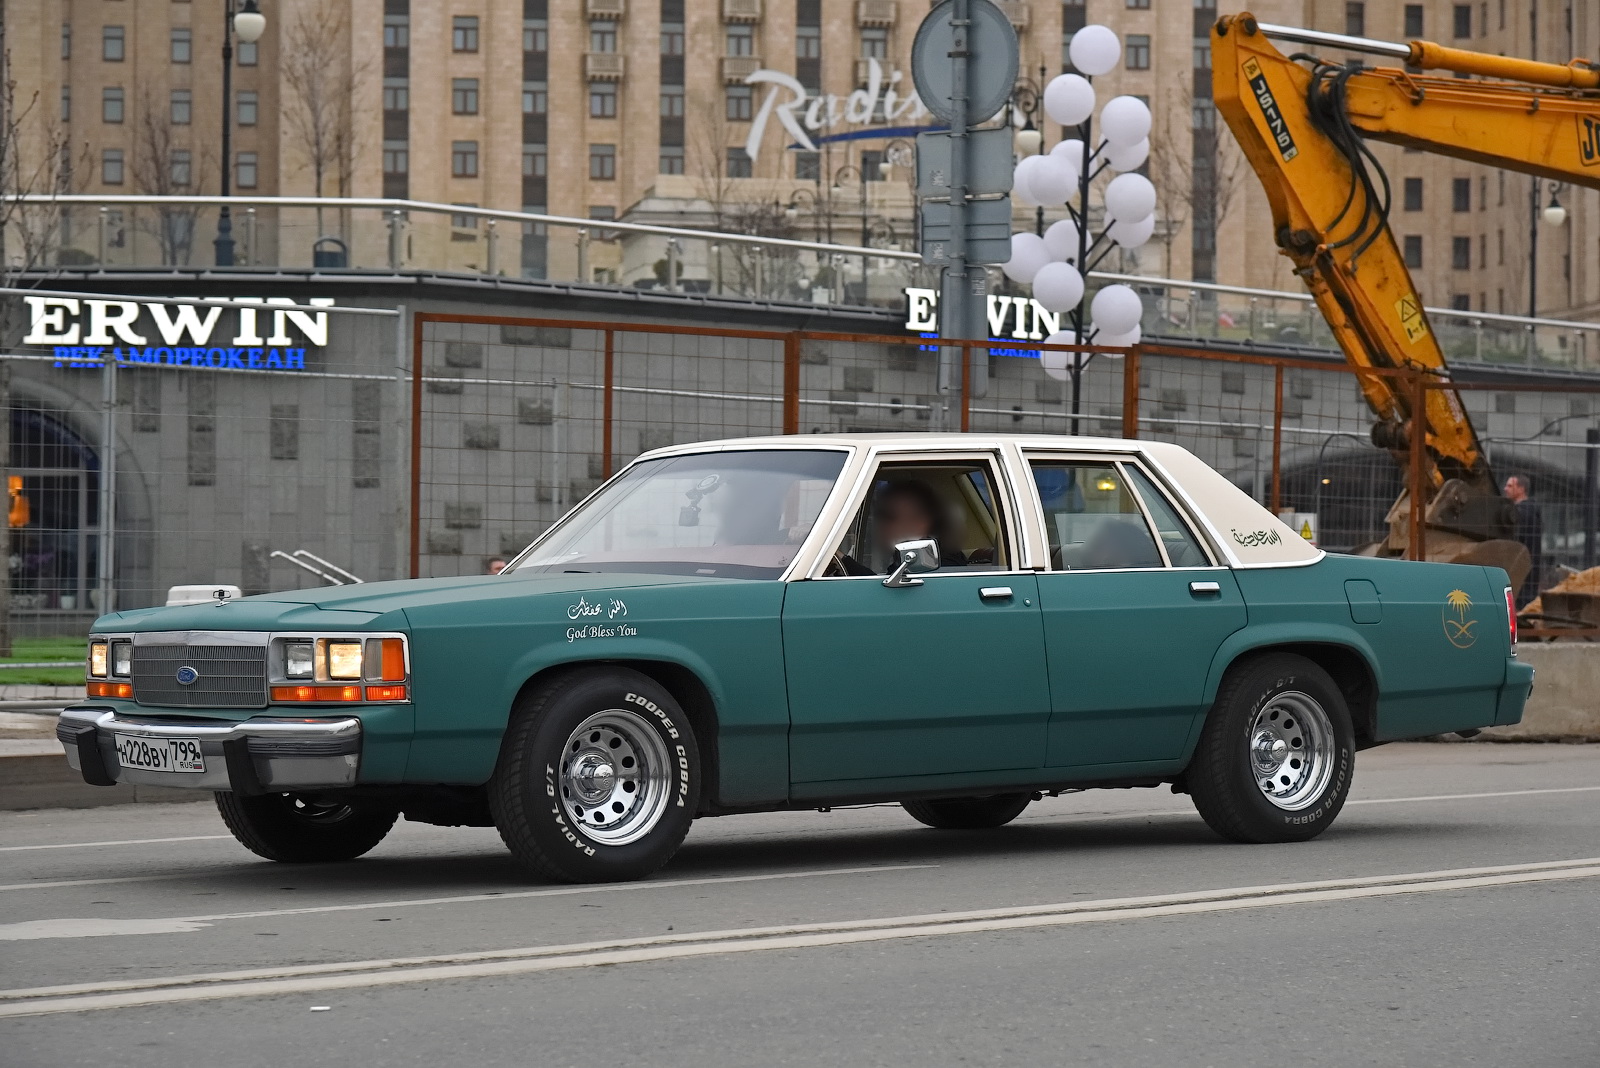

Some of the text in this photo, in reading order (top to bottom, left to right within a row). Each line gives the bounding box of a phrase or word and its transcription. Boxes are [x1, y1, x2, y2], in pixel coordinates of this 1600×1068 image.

[744, 57, 1026, 162] Radis
[23, 296, 335, 346] ERWIN
[905, 287, 1060, 340] EWIN
[566, 624, 637, 643] God Bless You
[170, 741, 197, 761] 799
[180, 761, 193, 769] RUS
[625, 692, 690, 808] COOPER COBRA
[1284, 747, 1349, 825] COOPER COBRA
[551, 802, 597, 857] RADIAL
